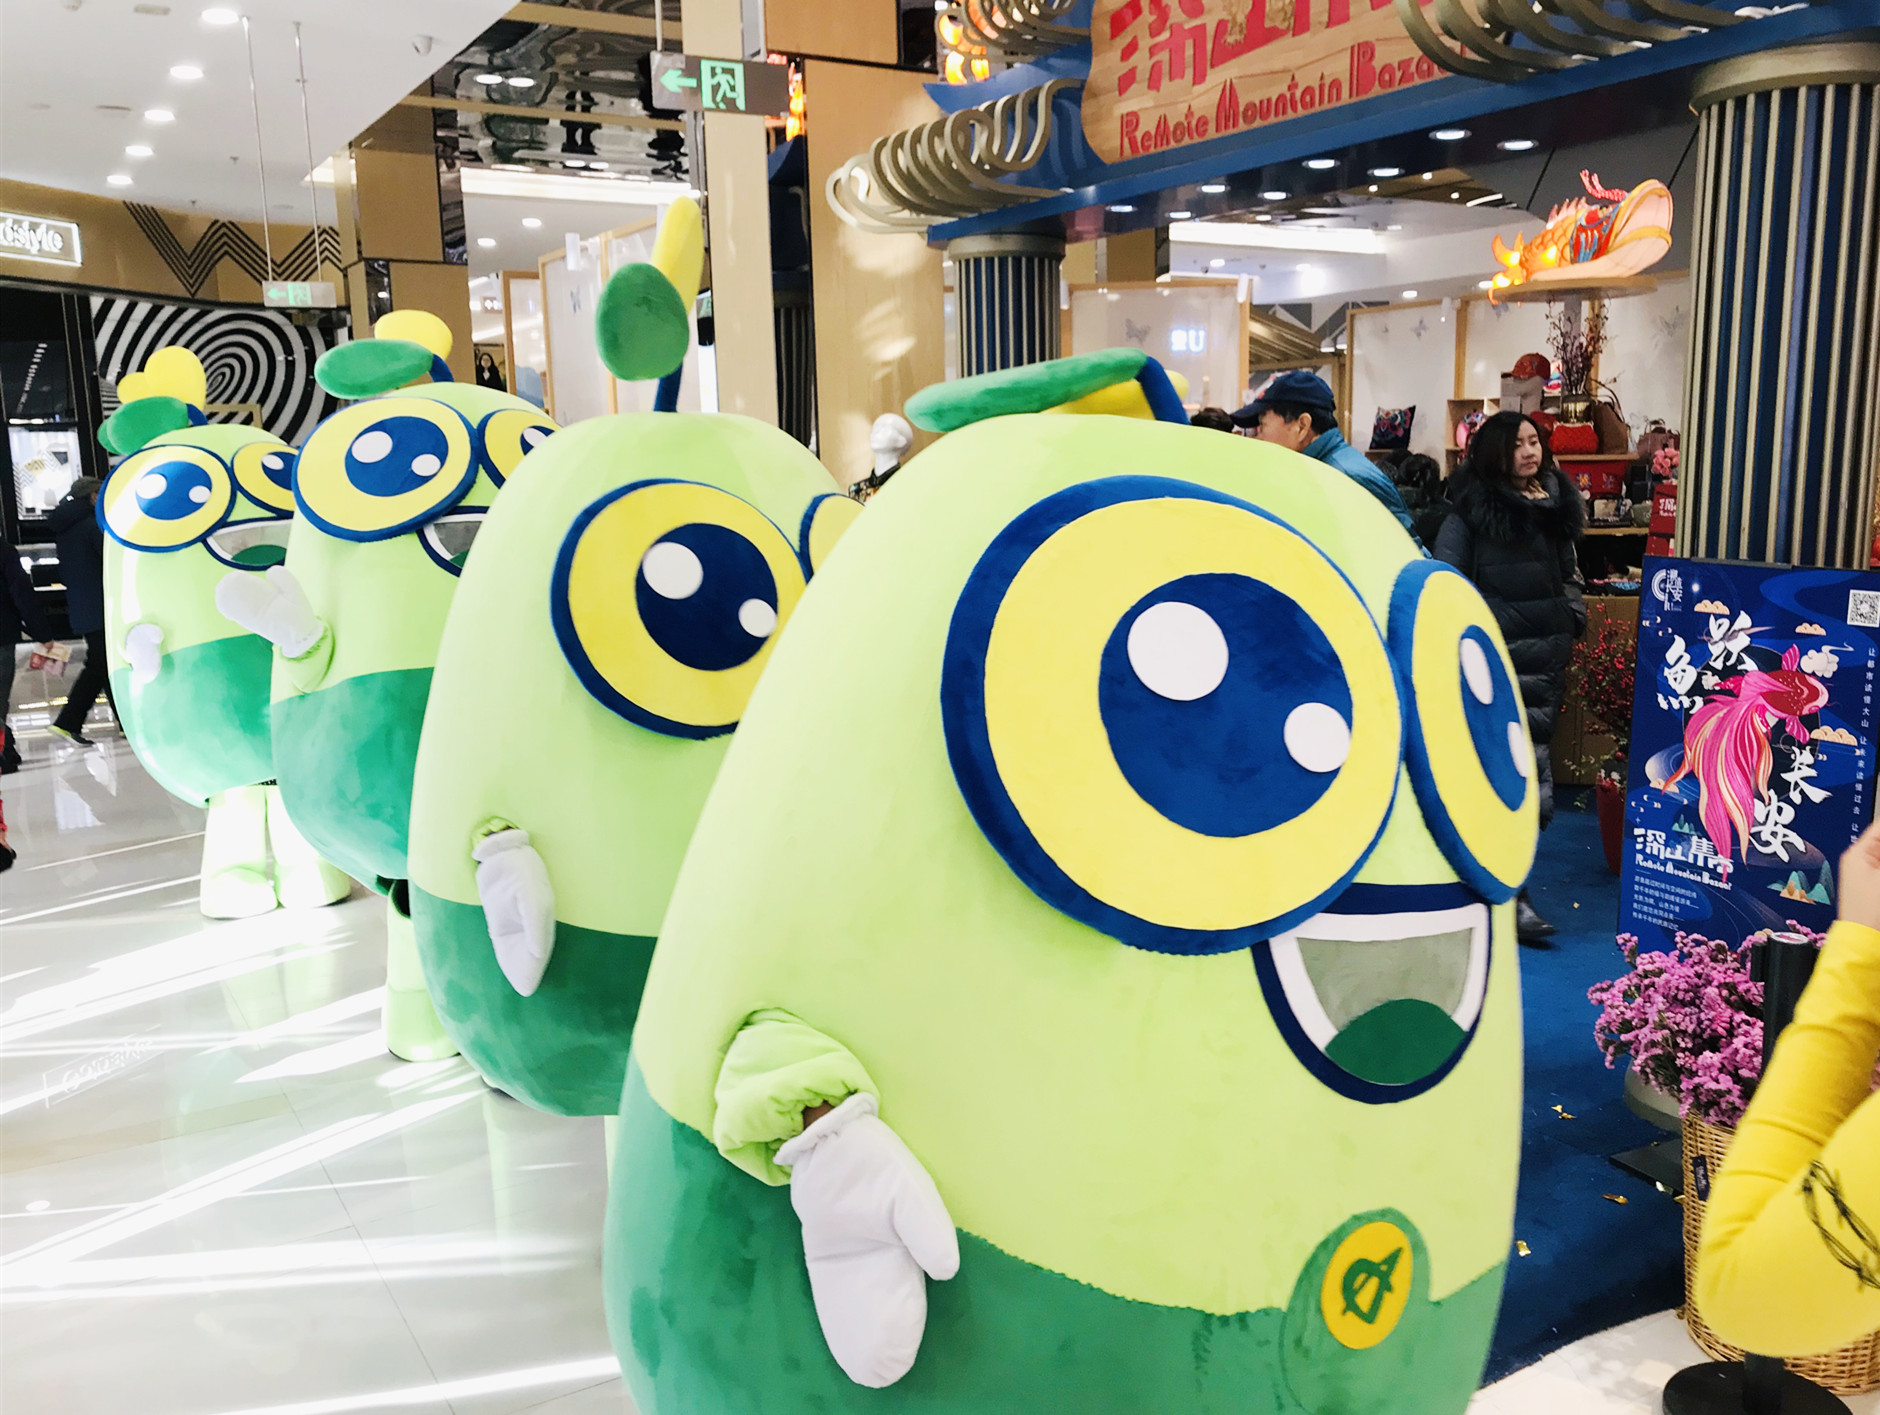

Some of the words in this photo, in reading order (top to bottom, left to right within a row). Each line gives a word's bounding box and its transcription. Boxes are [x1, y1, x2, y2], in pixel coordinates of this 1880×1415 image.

[1216, 72, 1342, 133] Mountain
[1634, 828, 1735, 874] 深山集市
